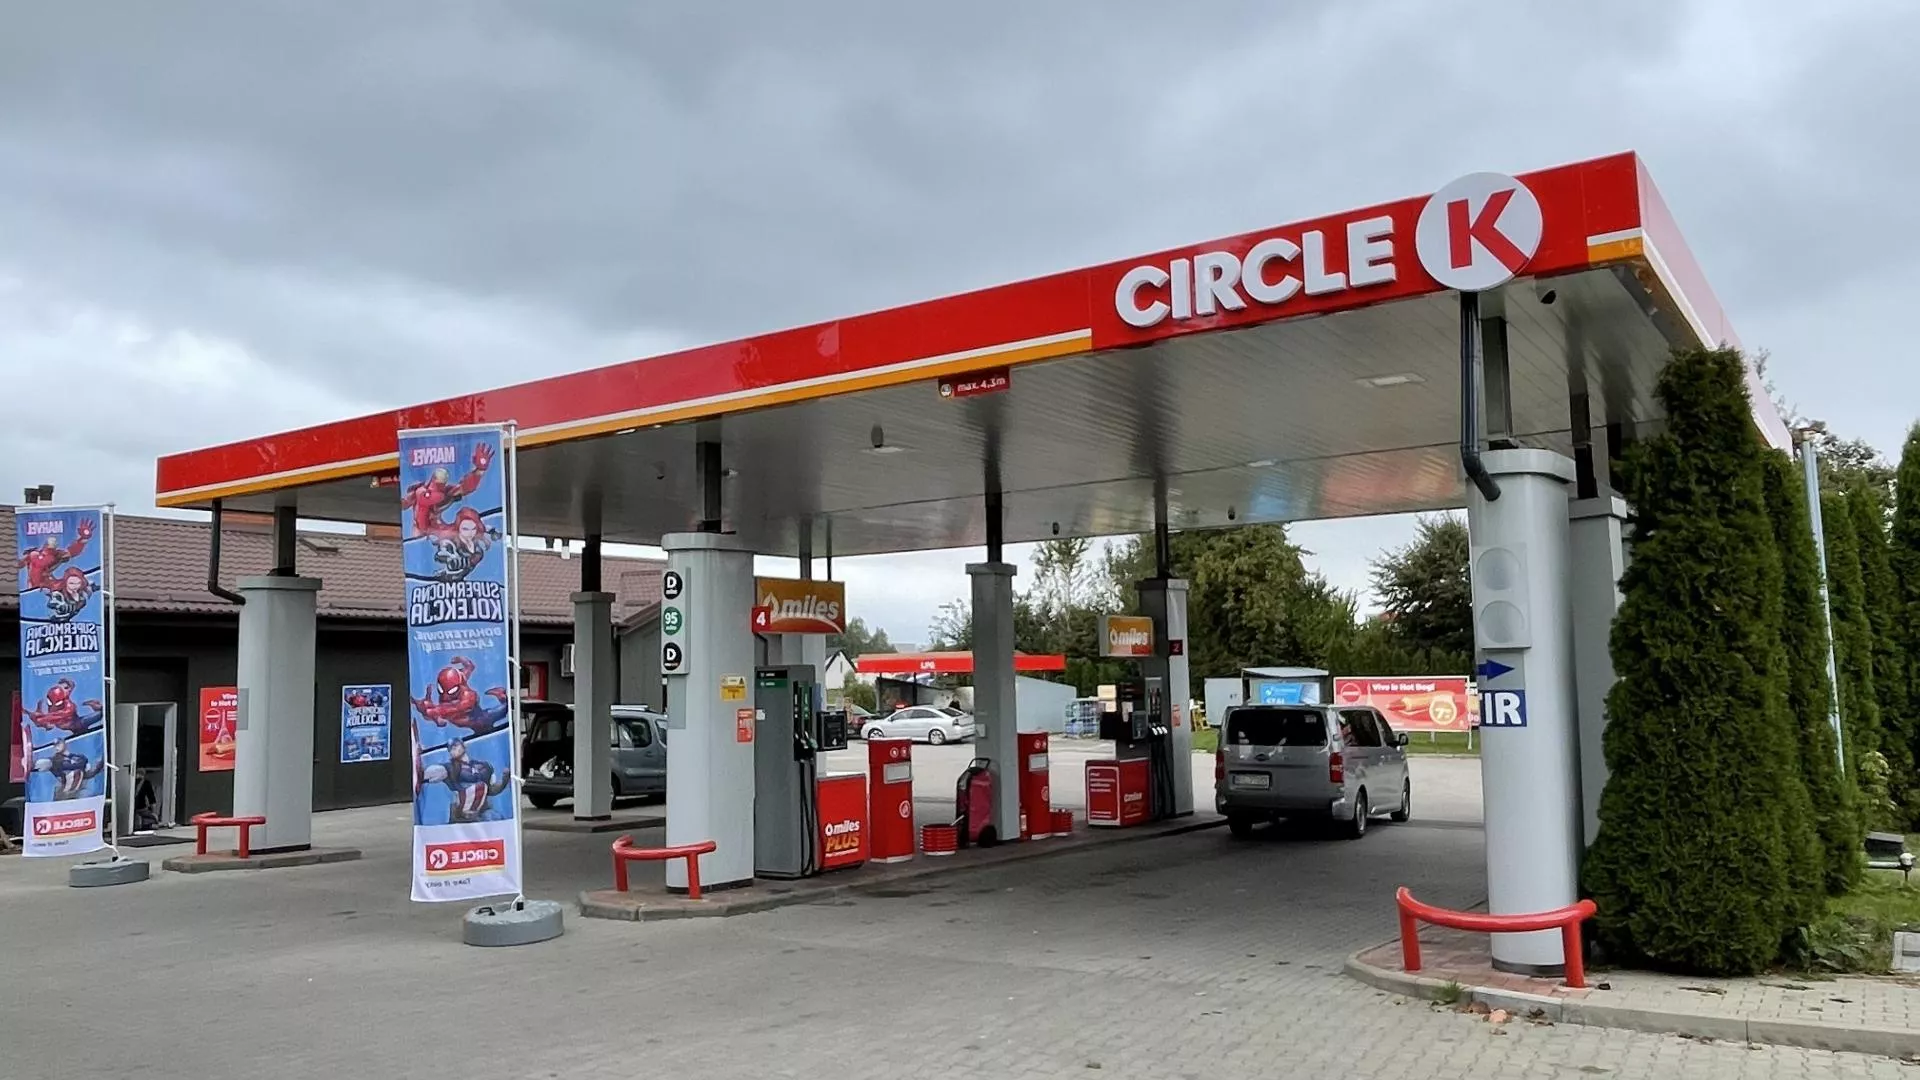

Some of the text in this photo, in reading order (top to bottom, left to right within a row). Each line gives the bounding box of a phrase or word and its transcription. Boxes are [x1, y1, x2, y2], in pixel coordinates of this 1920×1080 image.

[1115, 216, 1397, 328] CIRCLE
[666, 576, 677, 588] D
[781, 594, 840, 620] miles
[664, 611, 679, 625] 95
[756, 611, 766, 626] 4
[666, 647, 677, 661] D
[1480, 692, 1522, 725] IR
[833, 819, 860, 835] miles
[826, 834, 860, 852] PLUS
